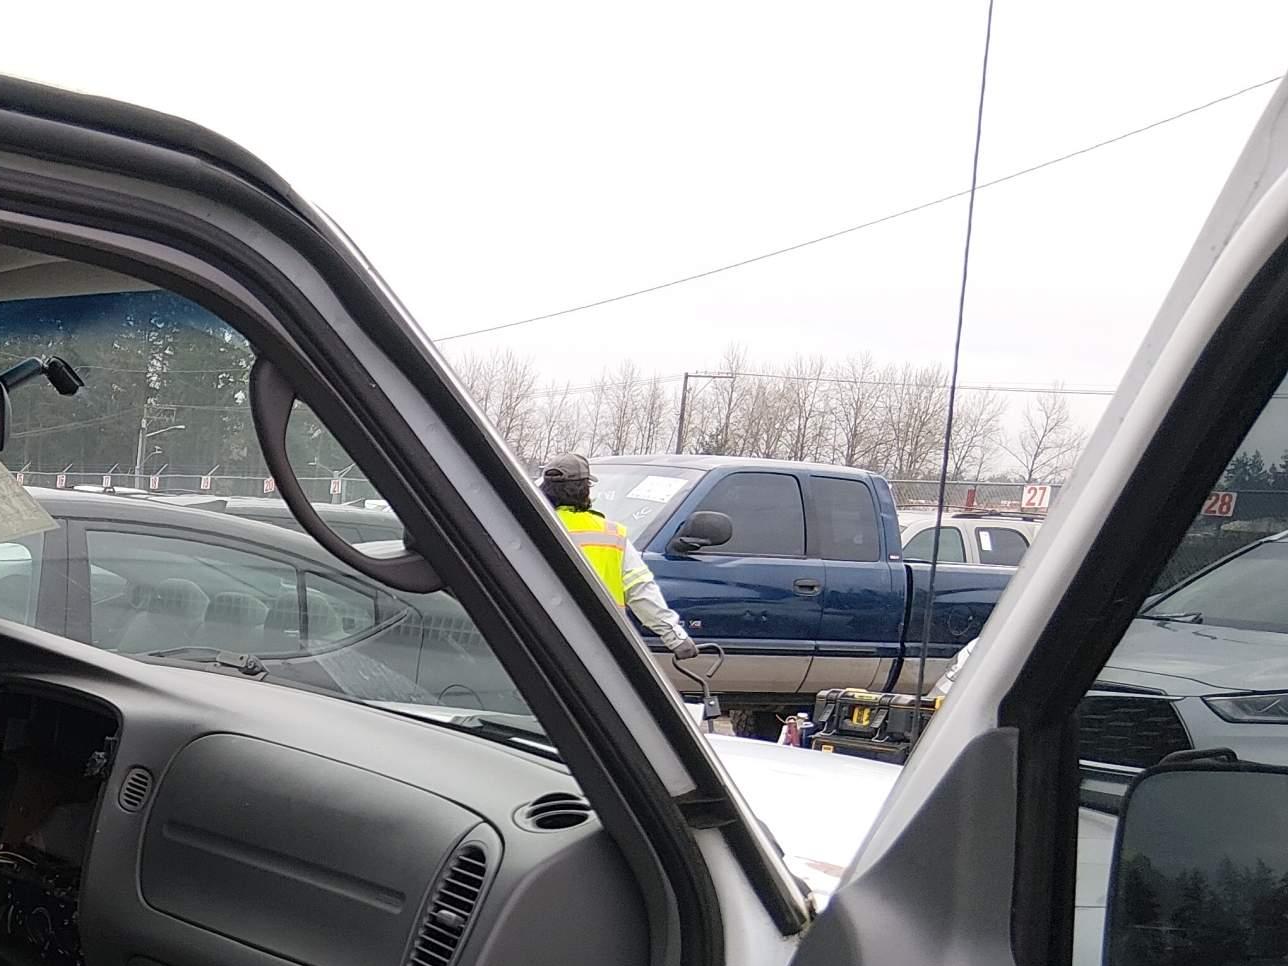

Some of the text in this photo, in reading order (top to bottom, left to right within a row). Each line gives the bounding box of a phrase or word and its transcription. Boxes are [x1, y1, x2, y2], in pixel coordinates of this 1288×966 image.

[264, 479, 274, 492] 20
[332, 480, 340, 493] 21
[1024, 486, 1048, 507] 27
[1204, 493, 1234, 515] 28
